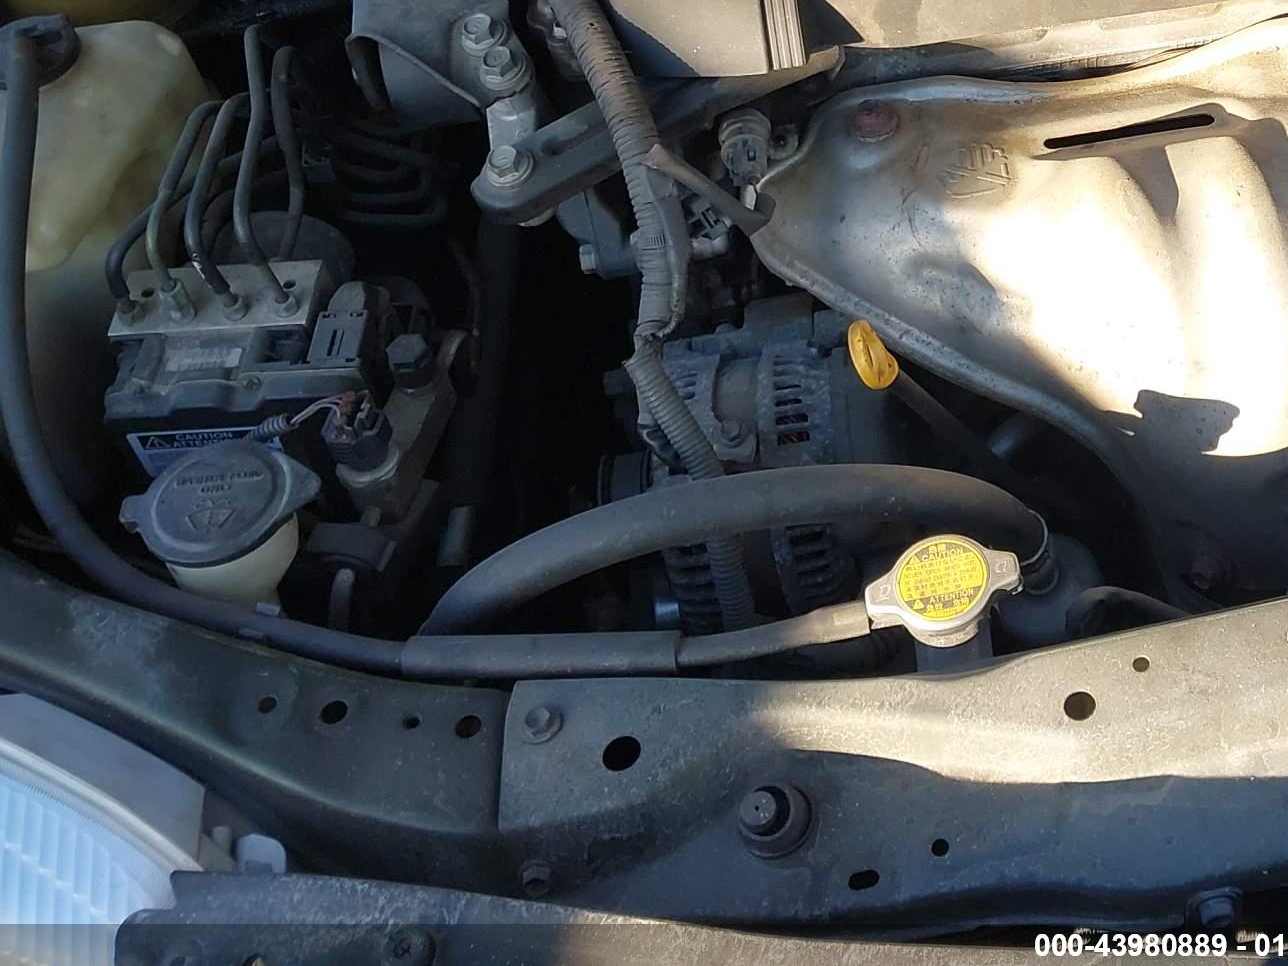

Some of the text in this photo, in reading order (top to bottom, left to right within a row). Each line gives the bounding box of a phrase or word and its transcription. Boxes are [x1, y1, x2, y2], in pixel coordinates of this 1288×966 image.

[175, 431, 233, 442] CAUTION
[922, 547, 964, 562] CAUTION
[929, 588, 975, 603] ATTENTION
